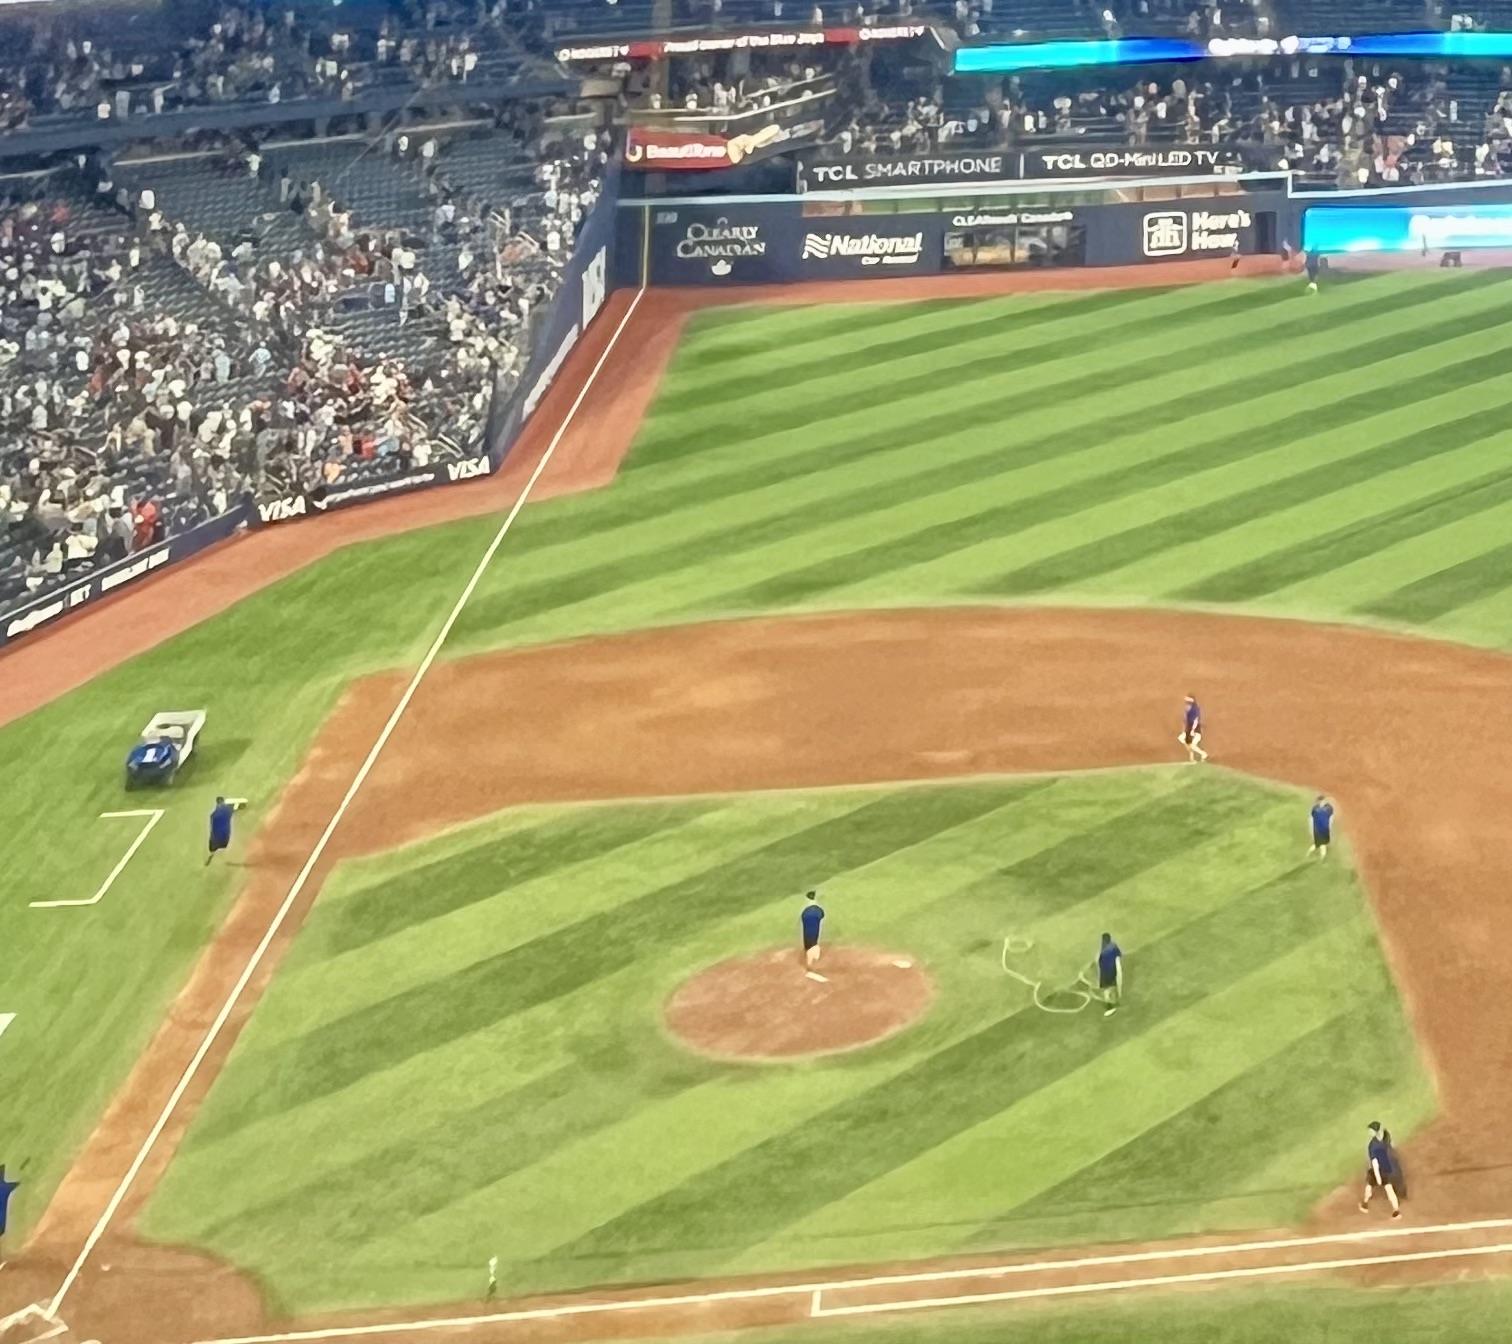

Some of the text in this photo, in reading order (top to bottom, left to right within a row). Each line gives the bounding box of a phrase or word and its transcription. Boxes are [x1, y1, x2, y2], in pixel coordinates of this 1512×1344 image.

[813, 157, 1002, 183] TCL SMARTPHONE
[1041, 154, 1087, 170] TCL
[1194, 150, 1220, 165] TV
[676, 239, 767, 258] CANADIAN
[829, 231, 923, 255] National
[447, 455, 491, 481] VISA
[258, 495, 307, 523] VISA
